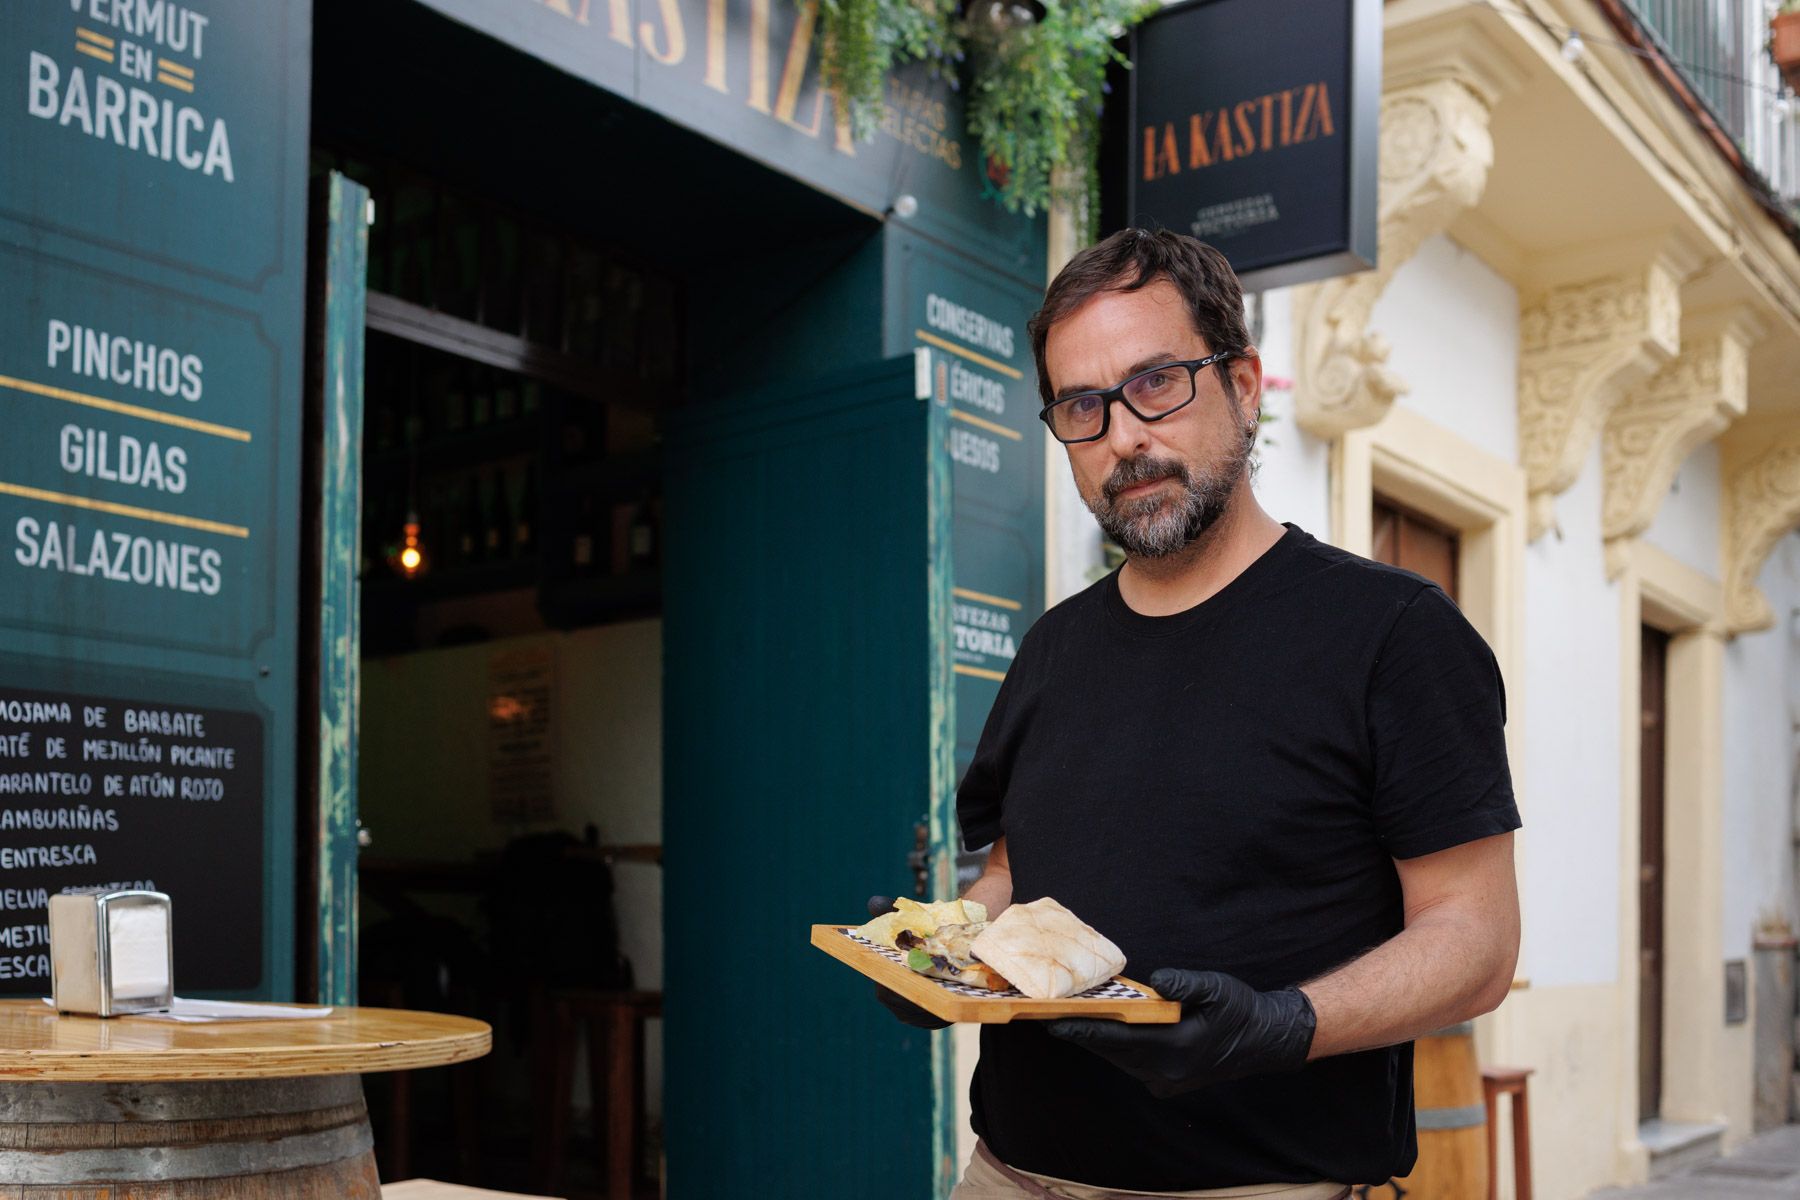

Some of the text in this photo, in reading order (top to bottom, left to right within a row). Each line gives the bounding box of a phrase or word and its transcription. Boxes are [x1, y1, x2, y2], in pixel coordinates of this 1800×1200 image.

[119, 39, 152, 82] EN
[28, 50, 234, 183] BARRICA
[880, 103, 962, 170] ELECTAS
[1143, 80, 1334, 181] LA KASTIZA
[926, 293, 1015, 358] CONSERVAS
[48, 319, 203, 401] PINCHOS
[951, 360, 1005, 415] ÉRICOS
[59, 424, 187, 494] GILDAS
[950, 427, 1000, 473] UESOS
[15, 516, 222, 596] SALAZONES
[953, 624, 1017, 660] TORIA
[83, 706, 107, 728] DE
[124, 709, 206, 738] BARBATE
[0, 732, 235, 769] ATÉ DE MEJILLÓN PICANTE
[0, 772, 224, 801] ARANTELO DE ATÚN ROJO
[0, 804, 119, 831] AMBURIÑAS
[1, 844, 97, 869] ENTRESCA
[0, 888, 48, 911] ELVA
